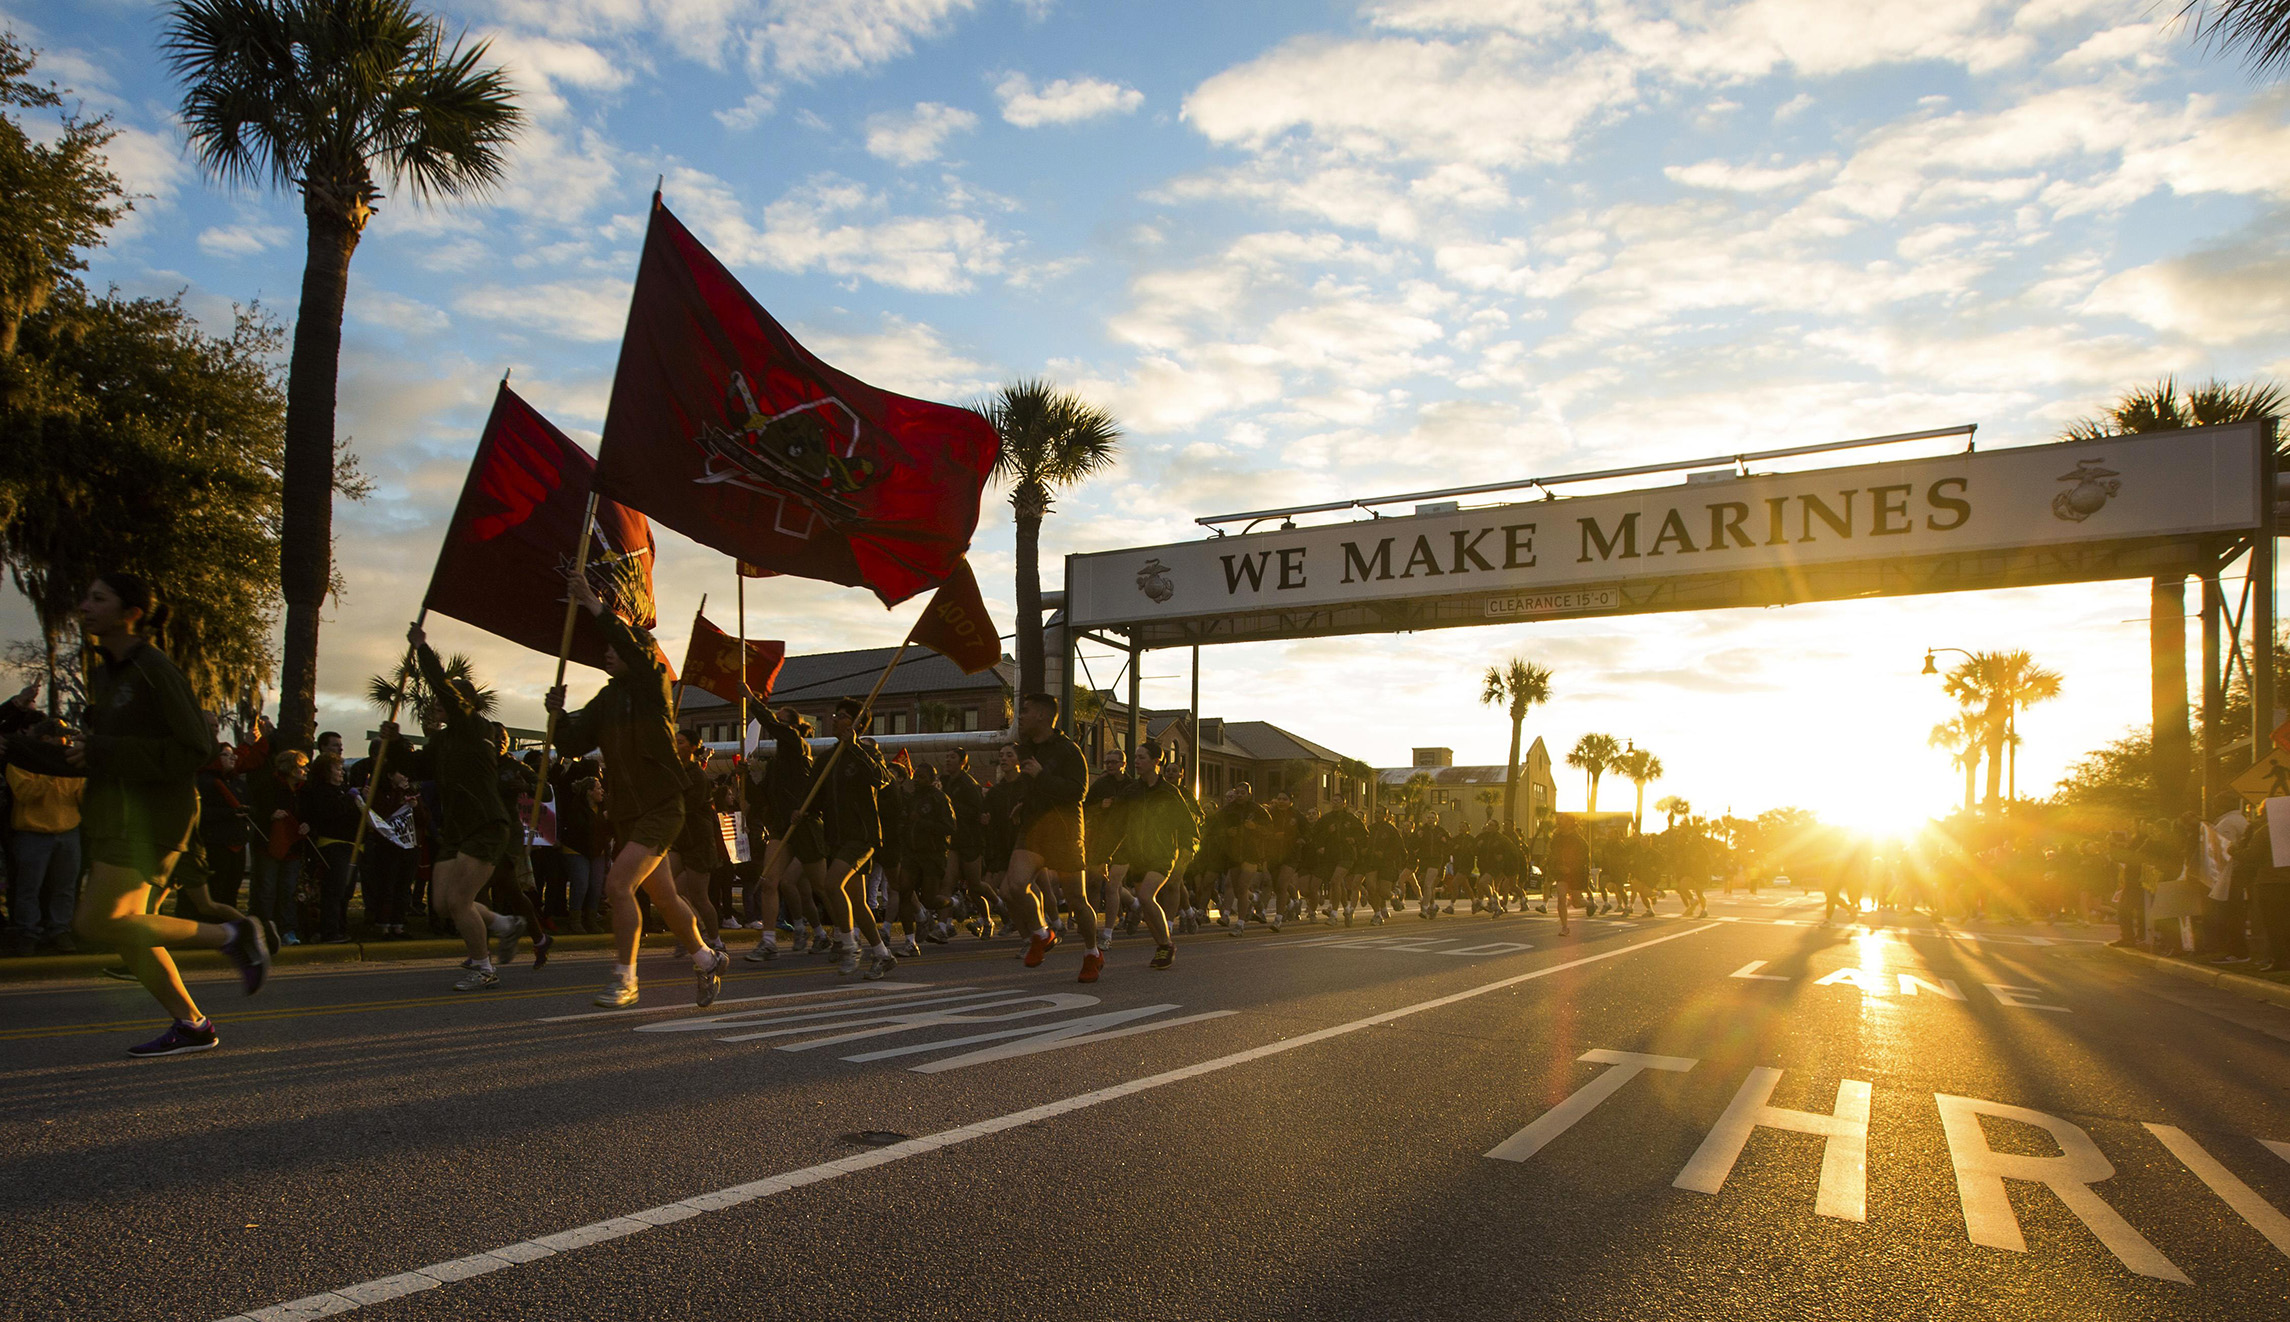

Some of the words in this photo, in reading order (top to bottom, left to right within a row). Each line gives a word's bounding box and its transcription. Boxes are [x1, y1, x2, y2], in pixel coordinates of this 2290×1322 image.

[1220, 547, 1307, 595] WE
[1340, 523, 1537, 584] MAKE
[1576, 477, 1972, 563] MARINES
[937, 600, 984, 647] 4007
[1490, 595, 1572, 613] CLEARANCE
[1260, 935, 1535, 956] YIELD
[1729, 960, 2073, 1013] LANE
[536, 981, 1242, 1074] TURN
